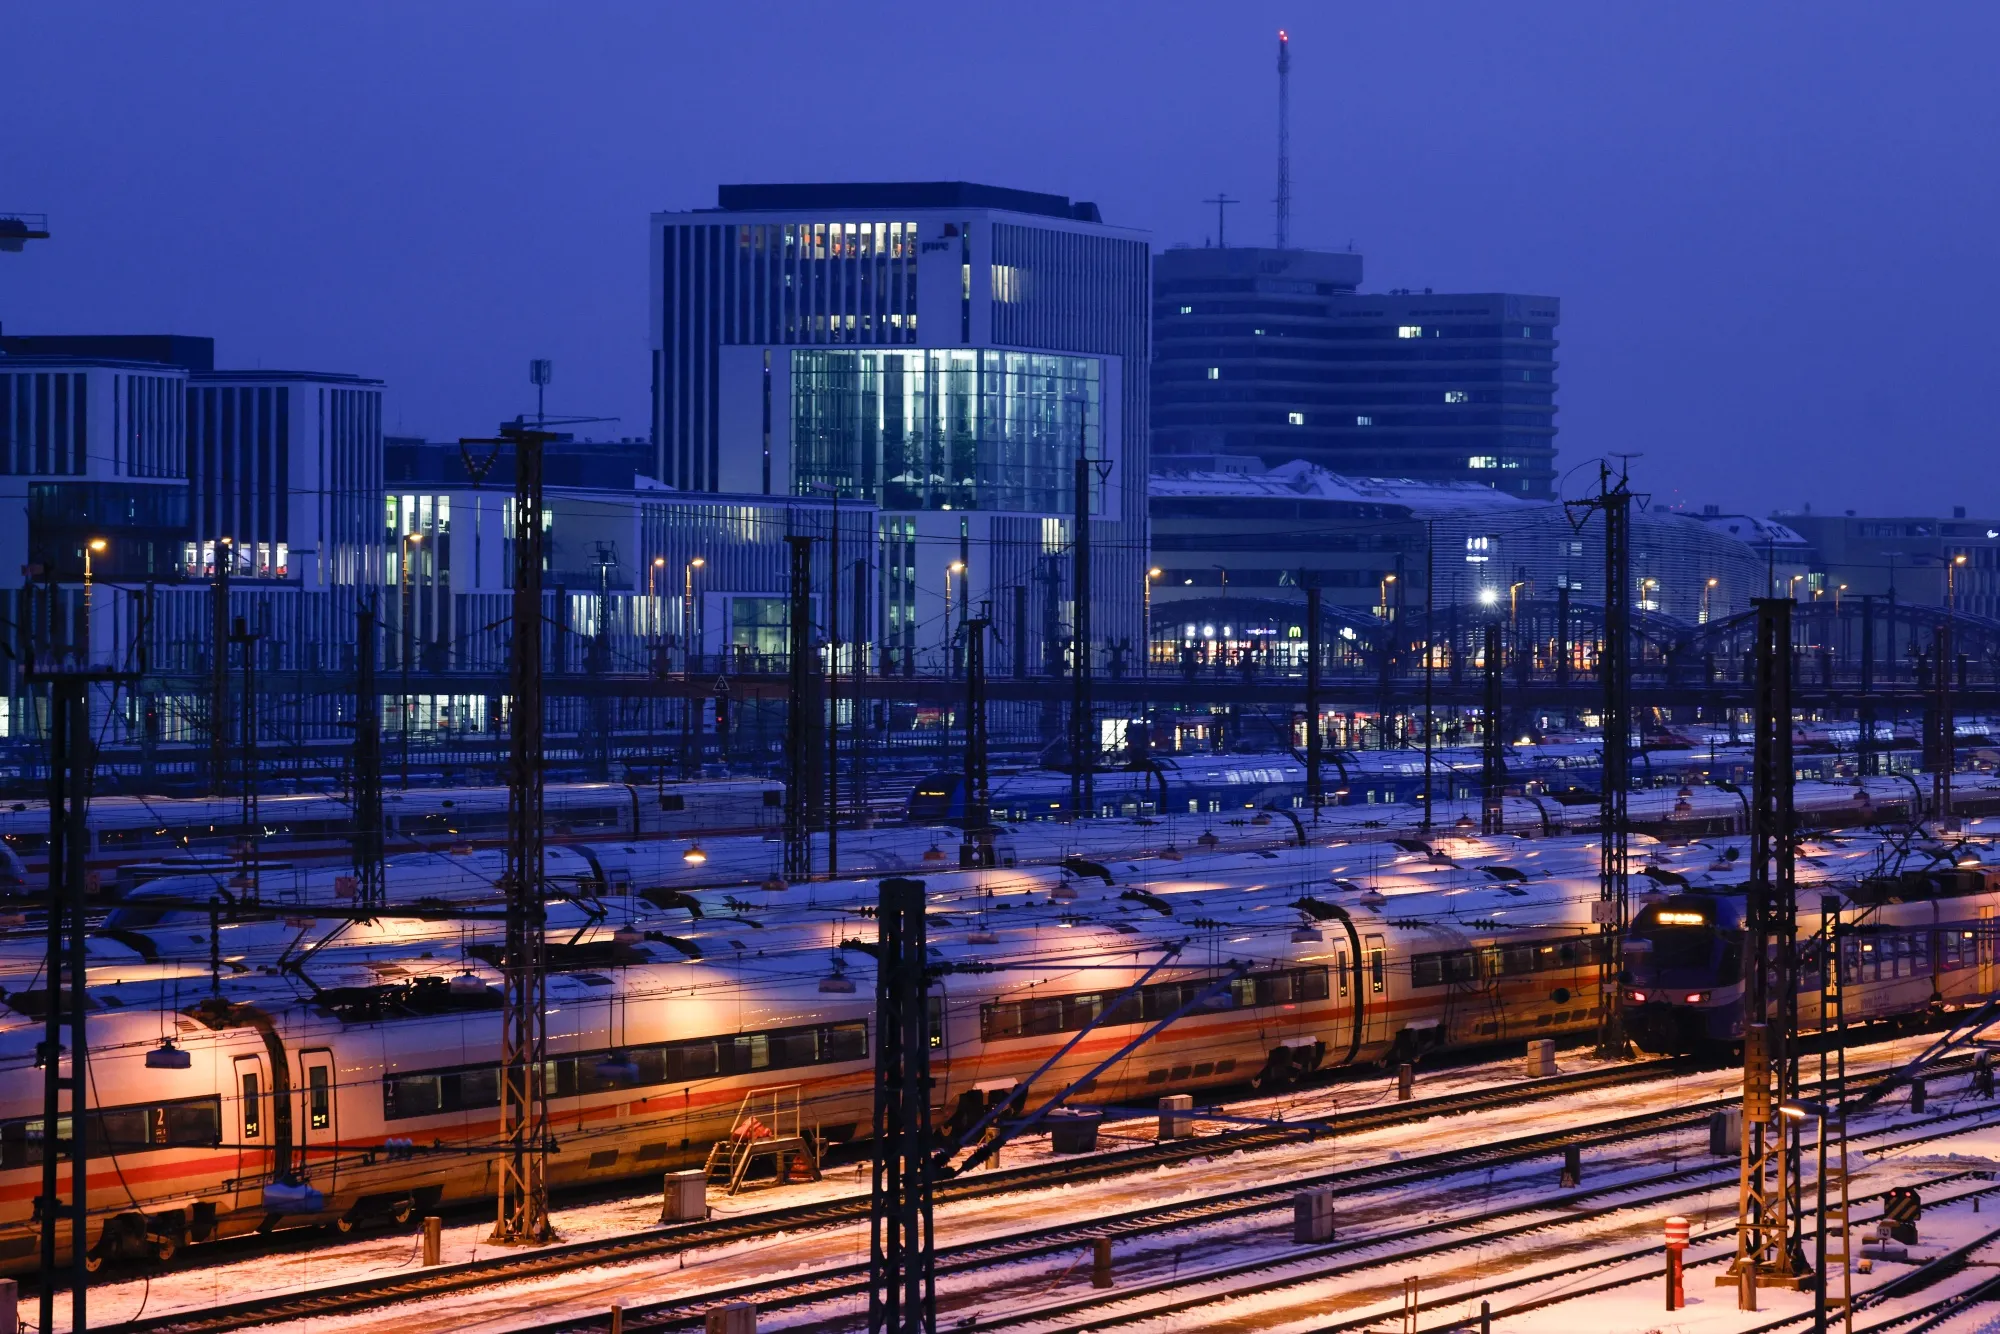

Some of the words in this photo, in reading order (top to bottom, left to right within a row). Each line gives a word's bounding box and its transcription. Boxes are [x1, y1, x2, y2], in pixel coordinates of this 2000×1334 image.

[922, 242, 949, 255] pwc
[387, 1080, 394, 1097] 2
[157, 1108, 164, 1126] 2
